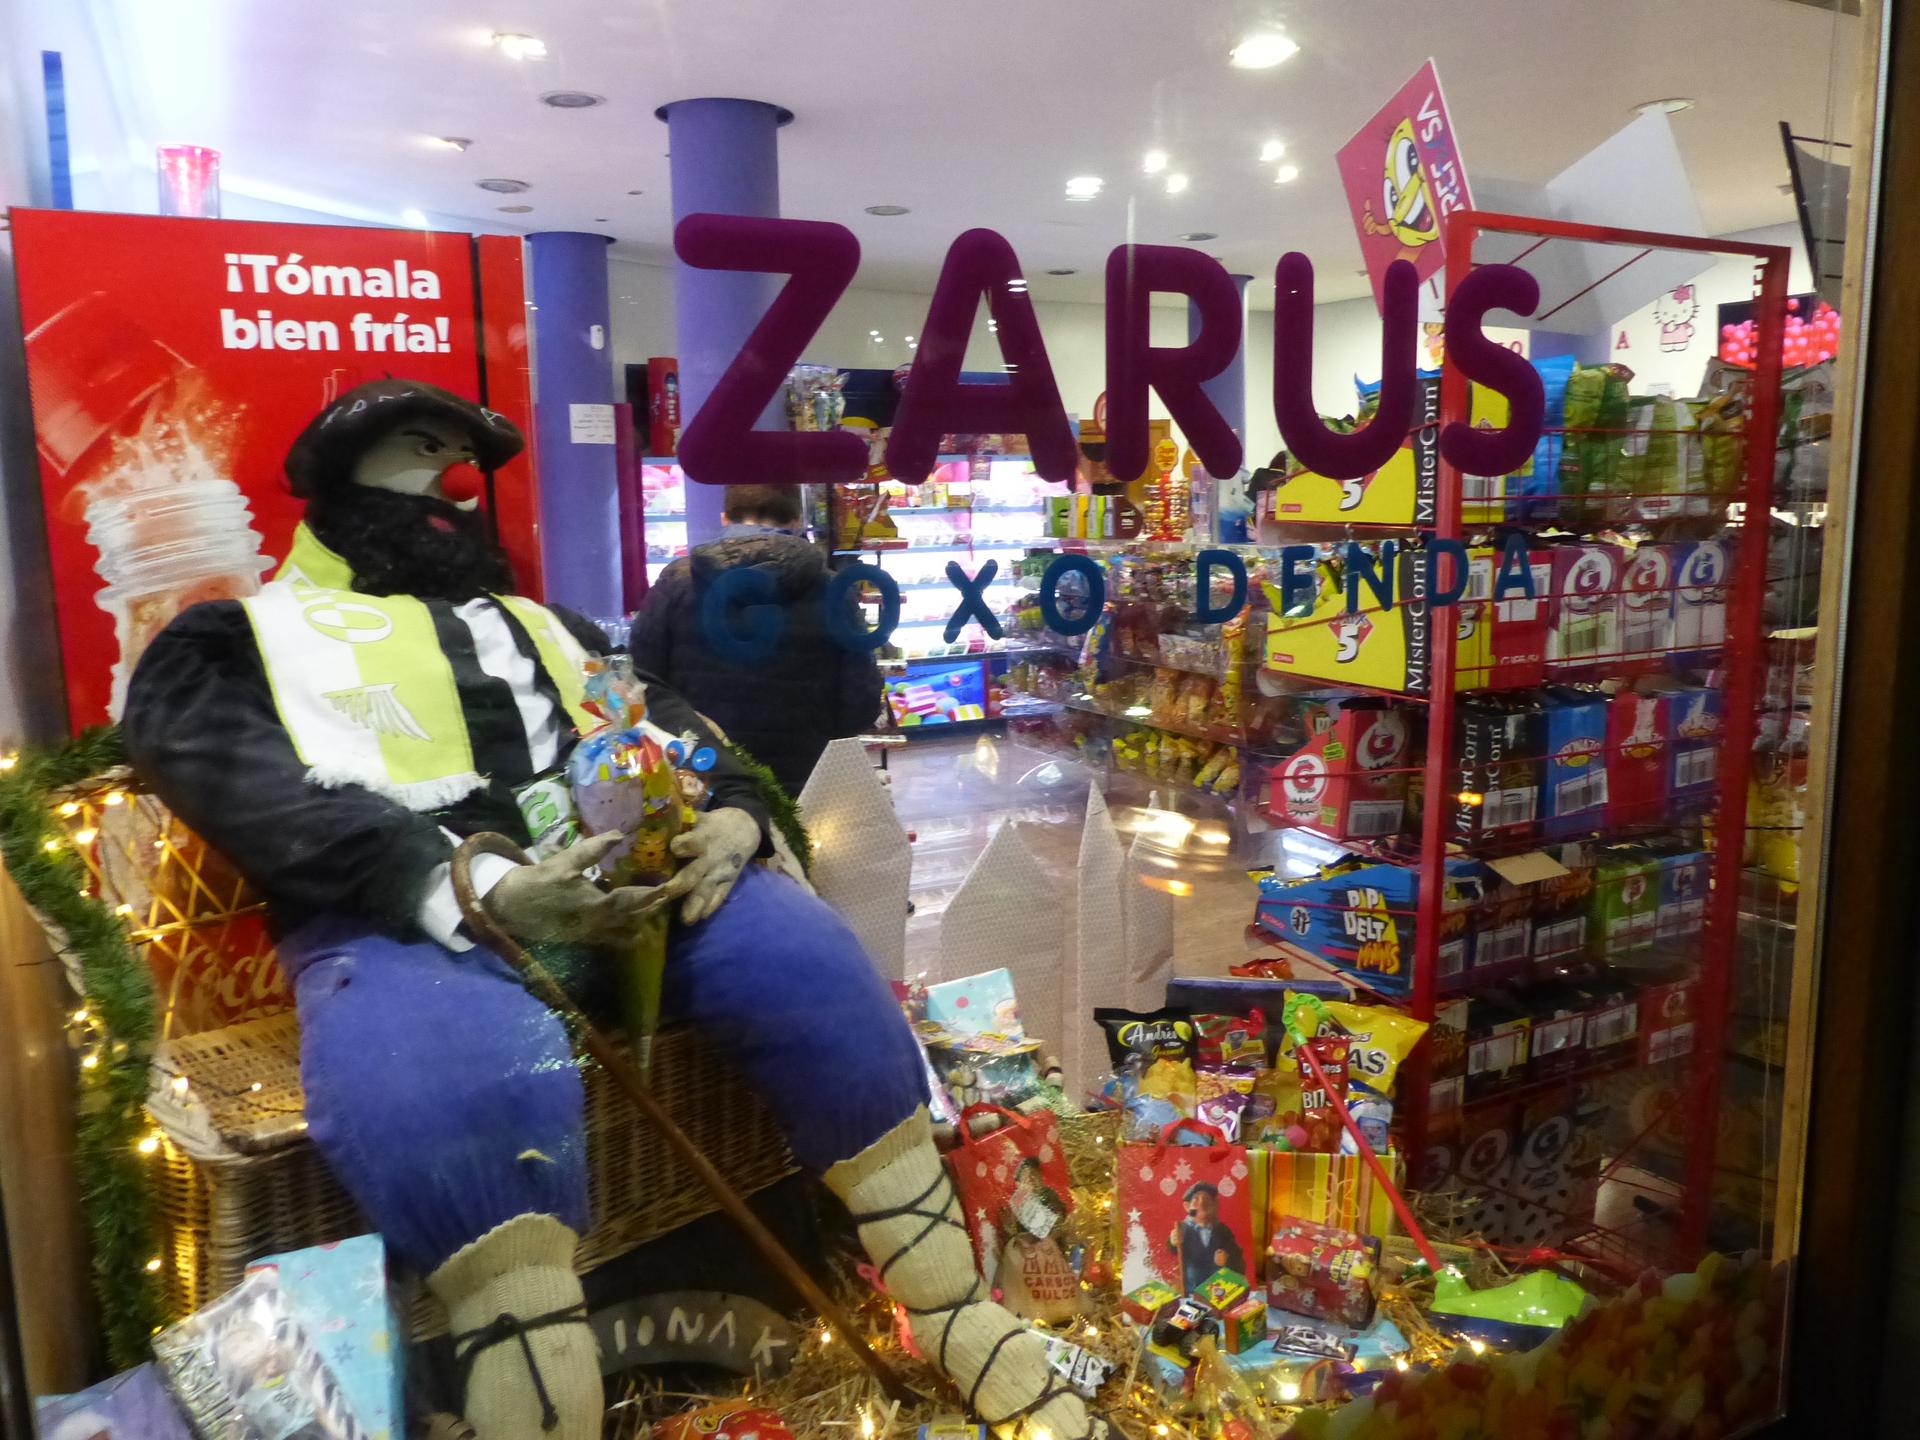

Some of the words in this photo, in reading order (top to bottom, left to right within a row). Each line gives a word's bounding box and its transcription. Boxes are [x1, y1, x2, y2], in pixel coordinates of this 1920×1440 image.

[220, 308, 340, 351] bien
[350, 312, 451, 353] fría!
[224, 252, 441, 299] ¡Tómala
[675, 213, 1545, 485] ZARUS
[1416, 385, 1438, 522] MisterCorn
[700, 554, 1105, 666] GOXO
[1197, 533, 1536, 624] DENDA
[1407, 558, 1427, 692] MisterCorn
[1454, 722, 1478, 846] MiserCorn
